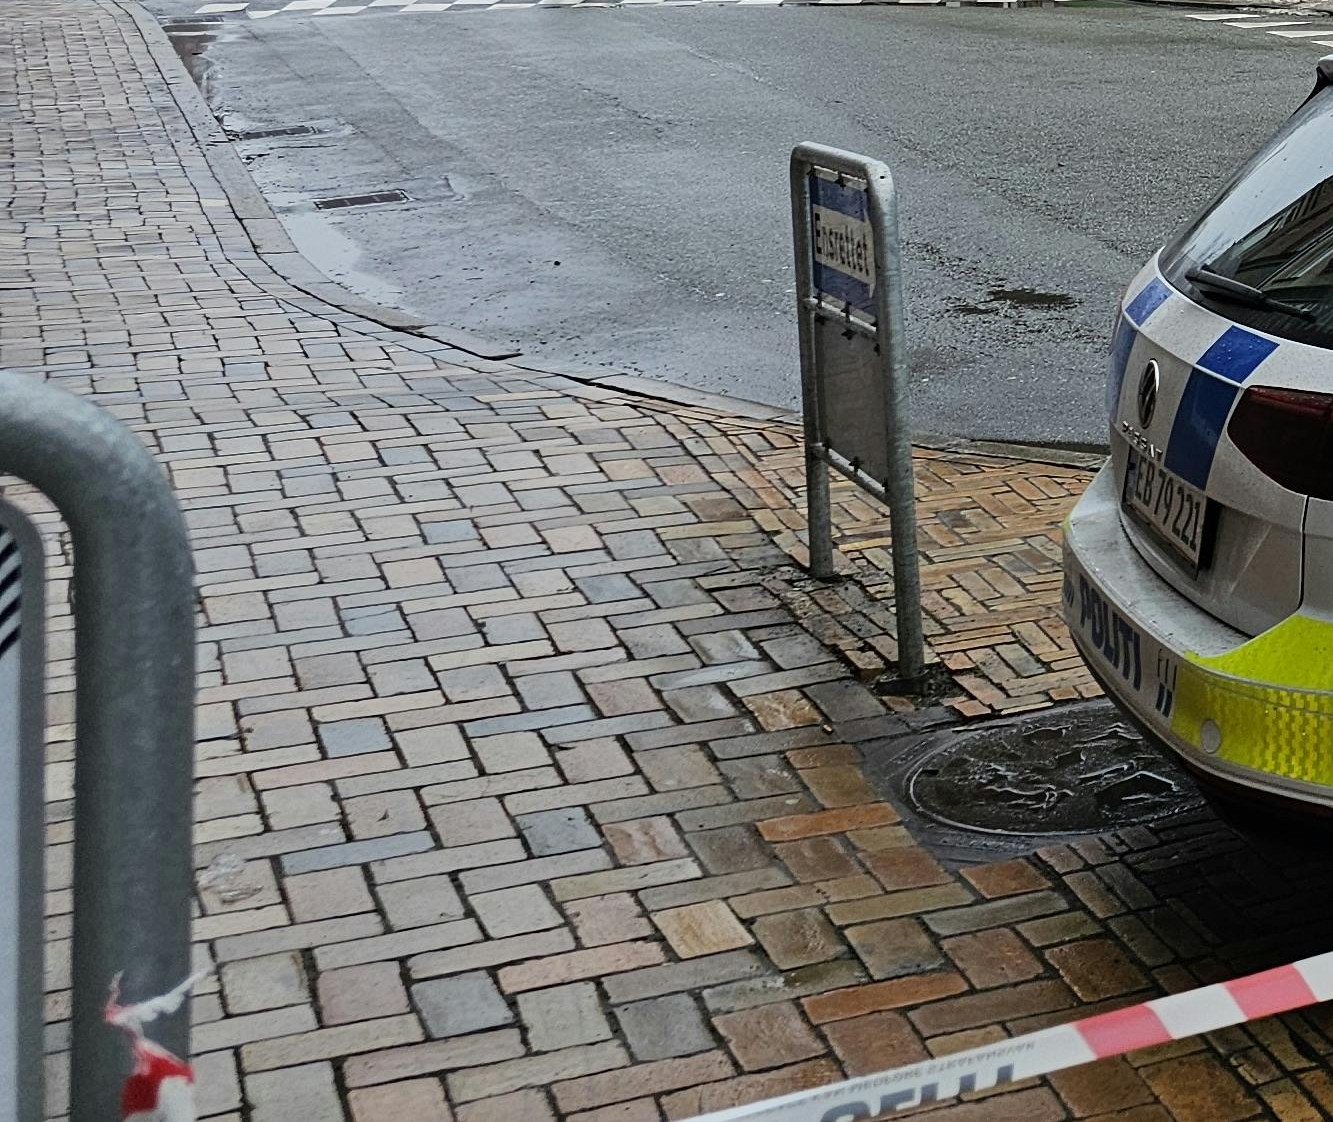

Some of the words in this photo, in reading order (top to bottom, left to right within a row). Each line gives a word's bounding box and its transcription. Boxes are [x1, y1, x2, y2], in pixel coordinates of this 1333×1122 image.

[1154, 468, 1174, 527] 79
[1171, 485, 1202, 553] 221
[1079, 573, 1142, 692] POLITI
